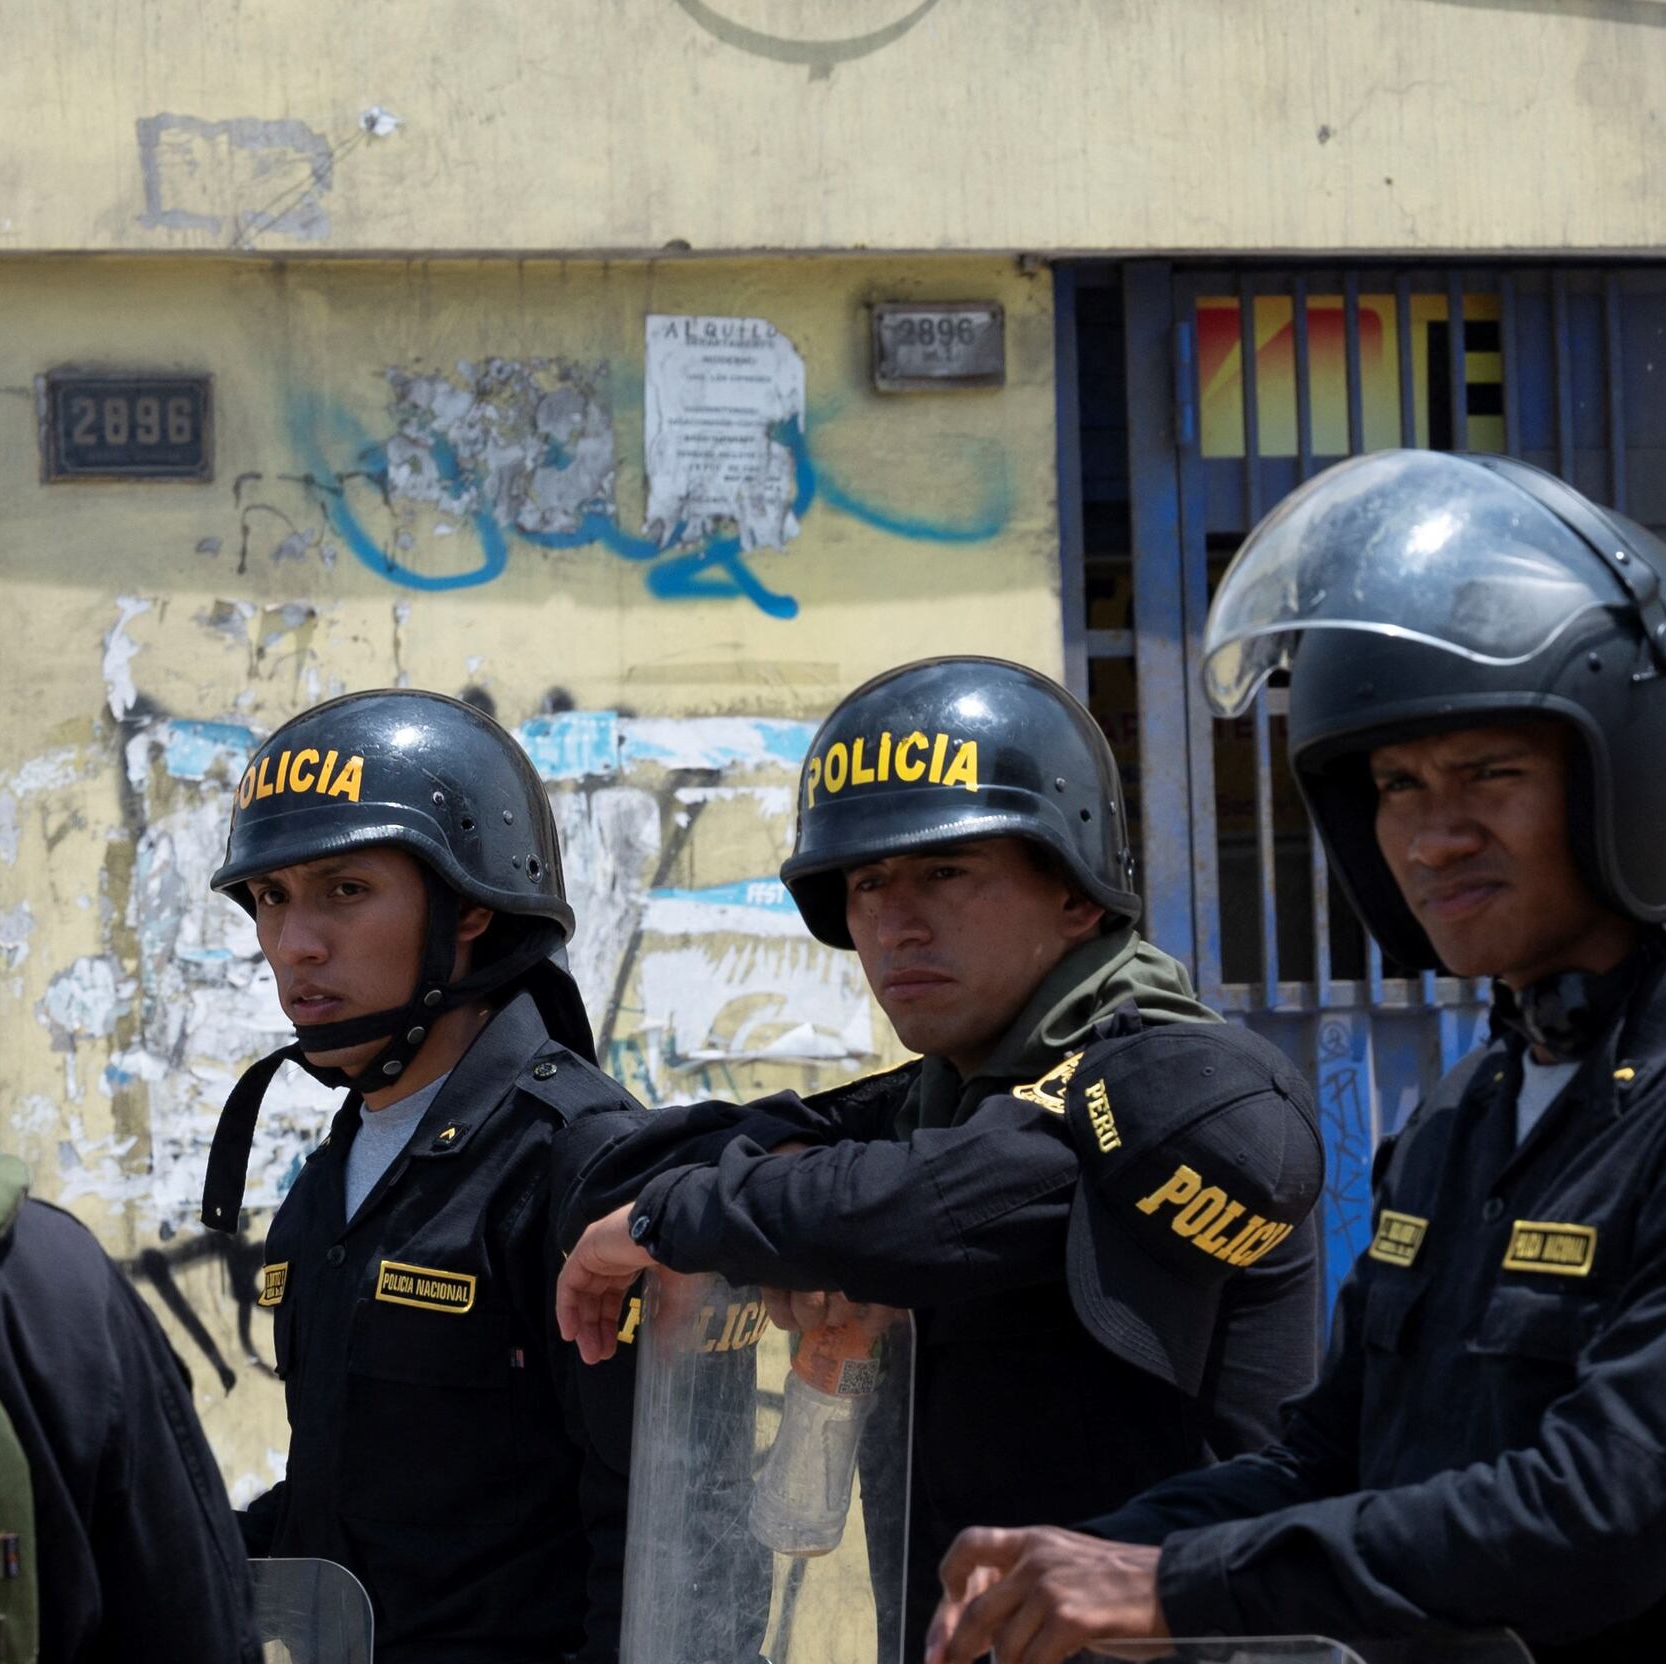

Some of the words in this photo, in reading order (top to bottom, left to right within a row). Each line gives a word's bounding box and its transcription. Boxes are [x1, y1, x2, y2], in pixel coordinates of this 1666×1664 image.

[71, 398, 193, 446] 2896
[233, 748, 365, 811] OLICIA
[807, 730, 979, 811] POLICIA
[1084, 1078, 1122, 1154] PERU
[382, 1273, 414, 1294] POLICIA
[415, 1278, 469, 1303] NACIONAL
